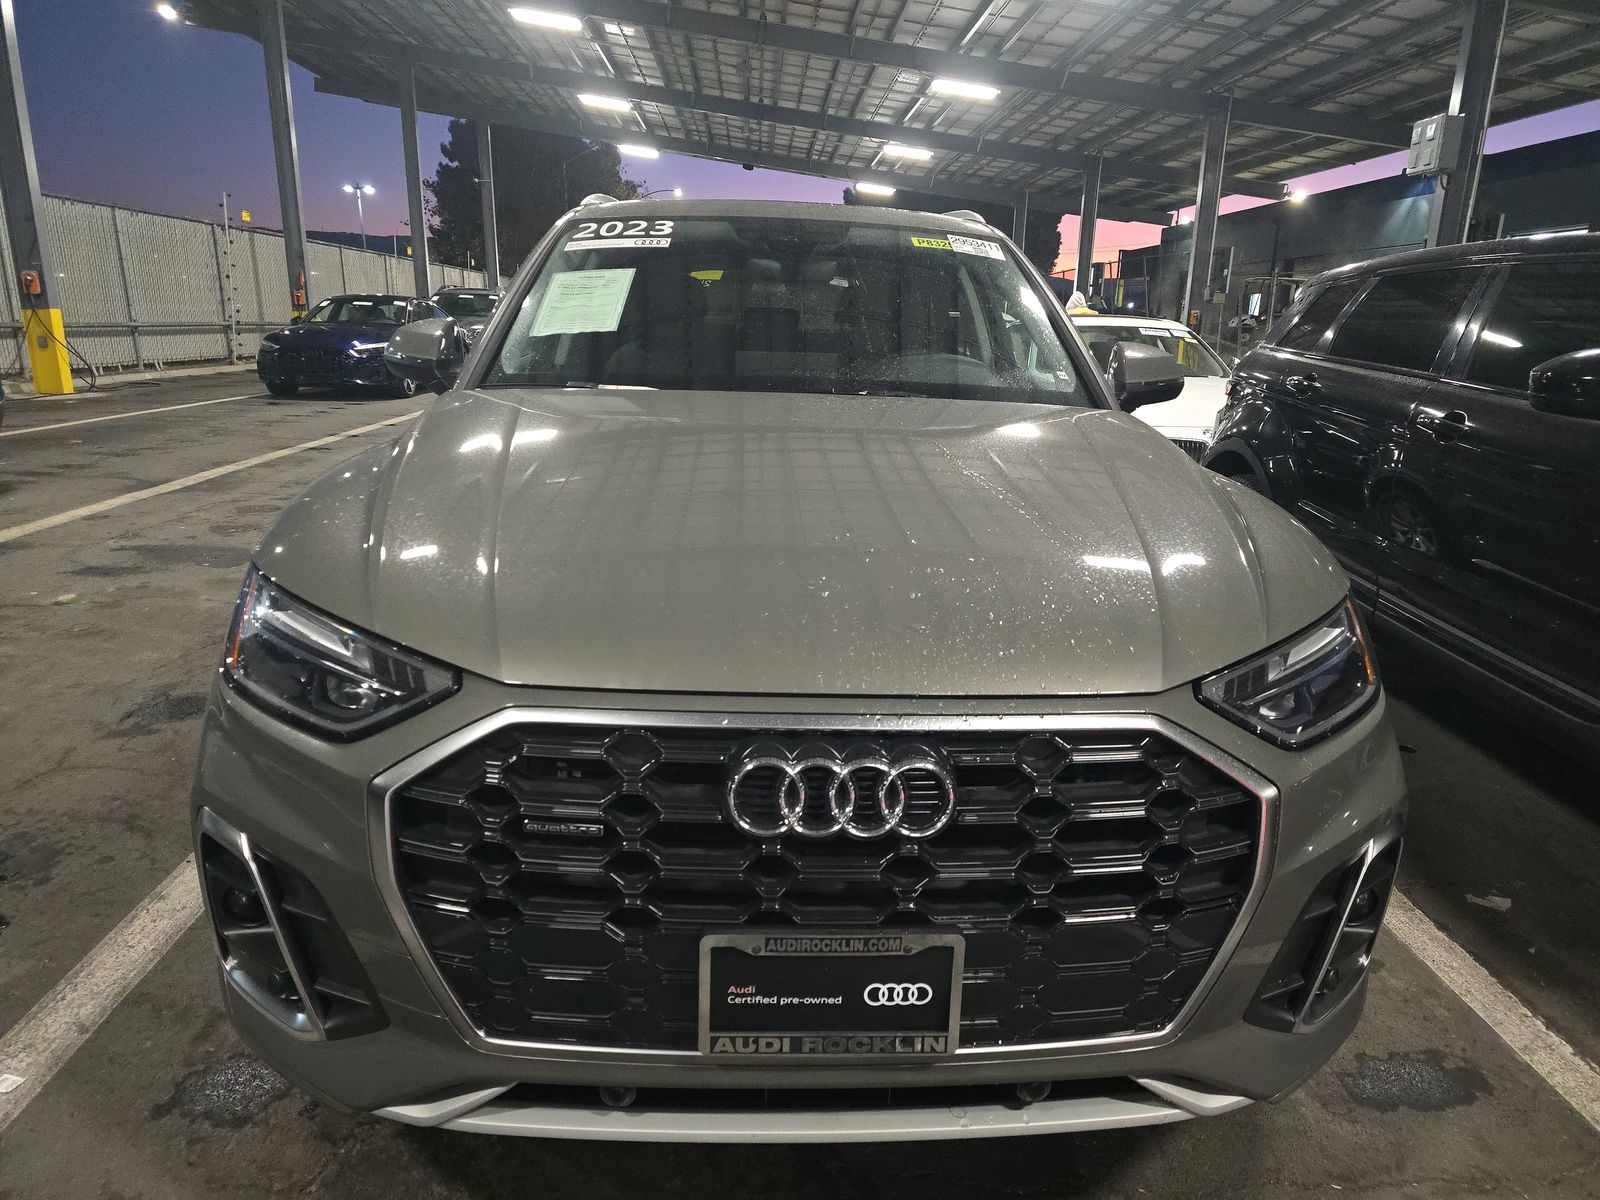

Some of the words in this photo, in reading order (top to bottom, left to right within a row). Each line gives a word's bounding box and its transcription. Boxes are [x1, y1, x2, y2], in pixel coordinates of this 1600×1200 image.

[572, 220, 675, 239] 2023
[951, 236, 1000, 252] 2953411
[526, 823, 599, 834] quattro
[766, 937, 902, 953] AUDIROCKLIN.COM
[727, 985, 756, 994] Audi
[727, 995, 777, 1005] Certified
[780, 995, 842, 1007] pre-owned
[712, 1037, 790, 1054] AUDI
[801, 1036, 947, 1054] ROCKLIN
